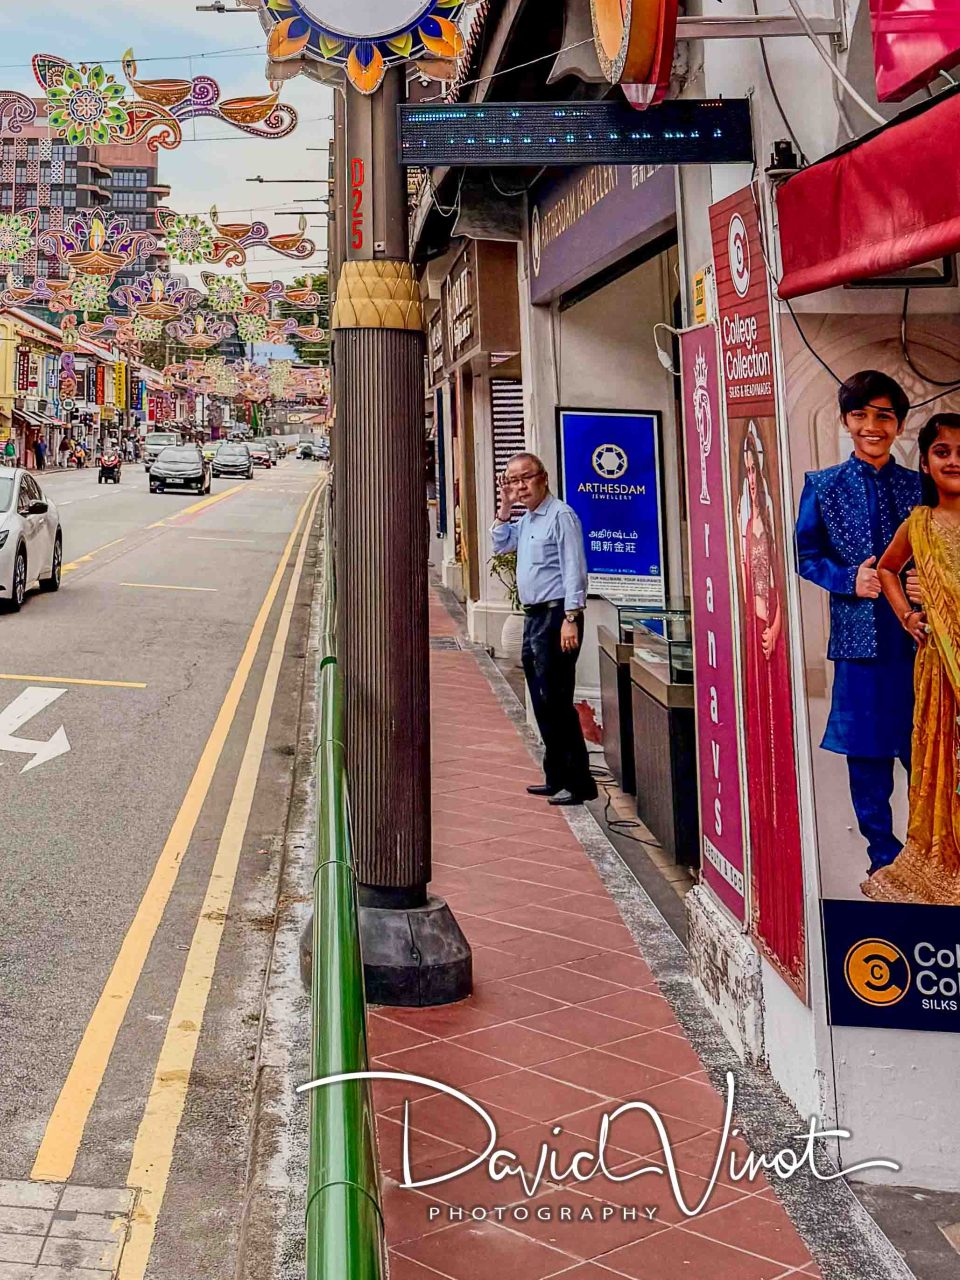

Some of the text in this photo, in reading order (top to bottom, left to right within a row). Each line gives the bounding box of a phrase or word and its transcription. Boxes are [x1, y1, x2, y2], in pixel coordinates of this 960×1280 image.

[723, 313, 757, 349] College
[726, 346, 770, 381] Collection
[577, 483, 646, 495] ARTHESDAM
[592, 493, 632, 501] JEWELLERY
[922, 998, 958, 1011] SILKS
